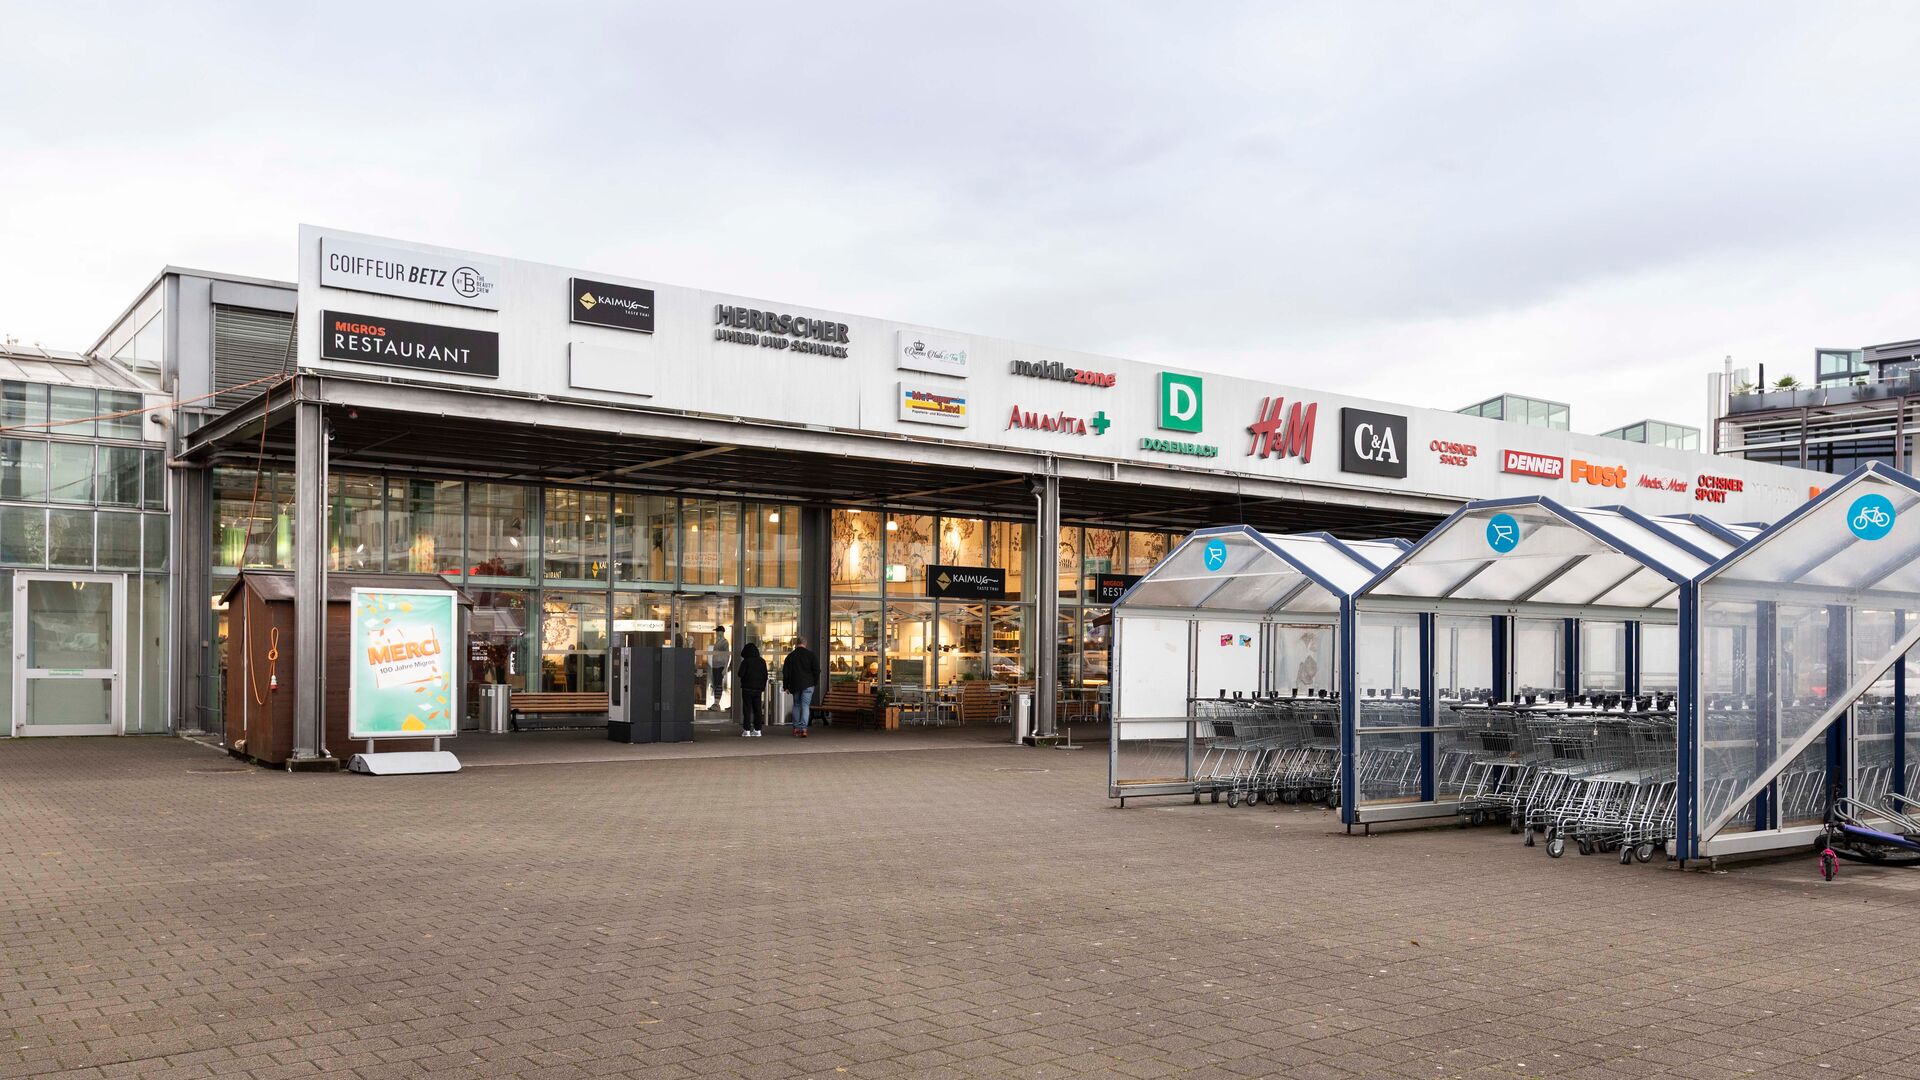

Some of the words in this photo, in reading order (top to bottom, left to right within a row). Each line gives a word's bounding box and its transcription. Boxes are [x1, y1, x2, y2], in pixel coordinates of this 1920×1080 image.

[330, 253, 405, 282] COIFFEUR
[408, 266, 447, 287] BETZ
[476, 281, 494, 289] BEAUTY
[335, 321, 386, 337] MIGROS
[714, 303, 850, 344] HERRSCHER
[335, 333, 471, 364] RESTAURANT
[714, 328, 760, 346] UHREN
[761, 335, 790, 350] UND
[790, 340, 849, 359] SCHMUCK
[1010, 360, 1116, 388] mobilezone
[1170, 382, 1197, 421] D
[1247, 396, 1318, 464] H&M
[1139, 437, 1219, 458] DOSENBACH
[1354, 422, 1400, 464] C&A
[1429, 440, 1477, 457] OCHSNER
[1439, 454, 1468, 467] SHOES
[1507, 453, 1562, 476] DENNER
[1570, 459, 1628, 489] Fust
[1698, 474, 1743, 492] OCHSNER
[1695, 487, 1727, 503] SPORT
[952, 574, 999, 586] KAIMUG
[368, 639, 441, 666] MERCI
[380, 666, 393, 674] 100
[394, 663, 414, 672] Jahre
